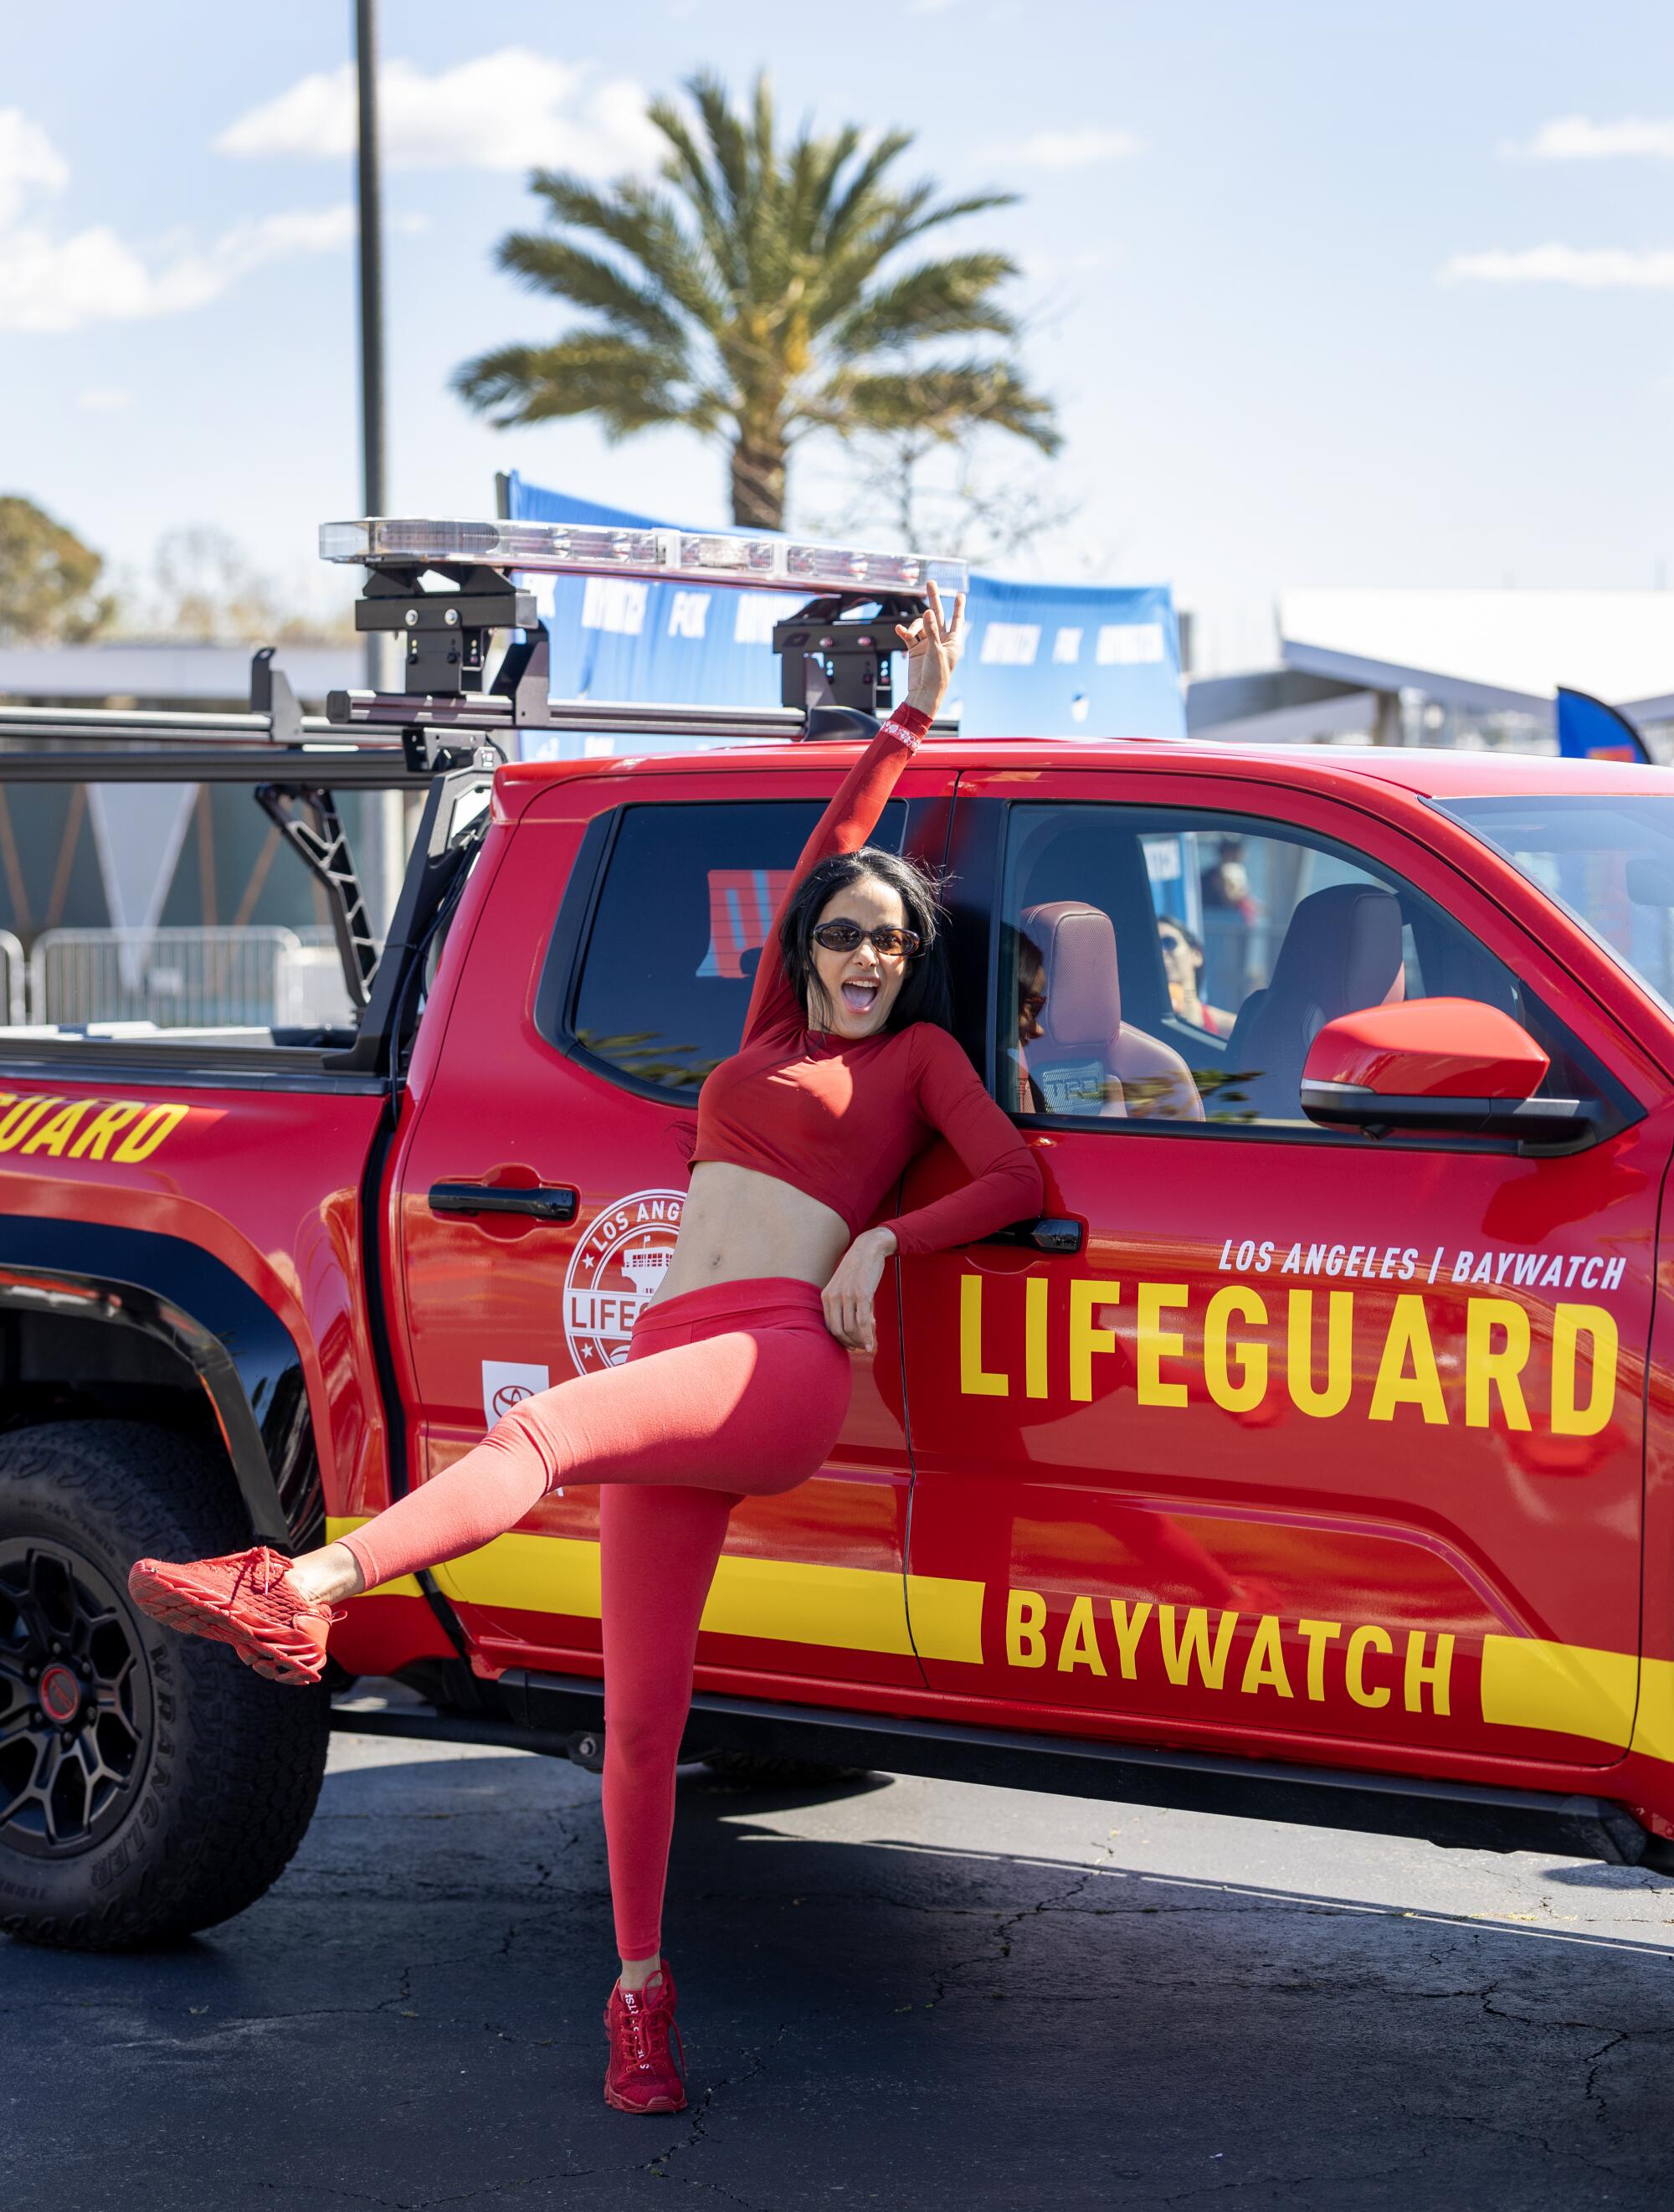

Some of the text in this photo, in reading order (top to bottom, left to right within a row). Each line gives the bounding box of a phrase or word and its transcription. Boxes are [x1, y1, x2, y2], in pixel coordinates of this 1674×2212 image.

[1045, 1076, 1099, 1102] TRD
[0, 1093, 190, 1163] UARD
[591, 1211, 629, 1253] LOS
[1219, 1239, 1275, 1272] LOS
[1281, 1243, 1419, 1280] ANGELES
[1451, 1250, 1627, 1290] BAYWATCH
[571, 1296, 649, 1332] LIFE
[960, 1274, 1619, 1437] LIFEGUARD
[1006, 1588, 1456, 1716] BAYWATCH
[90, 1642, 177, 1890] WRANGLER
